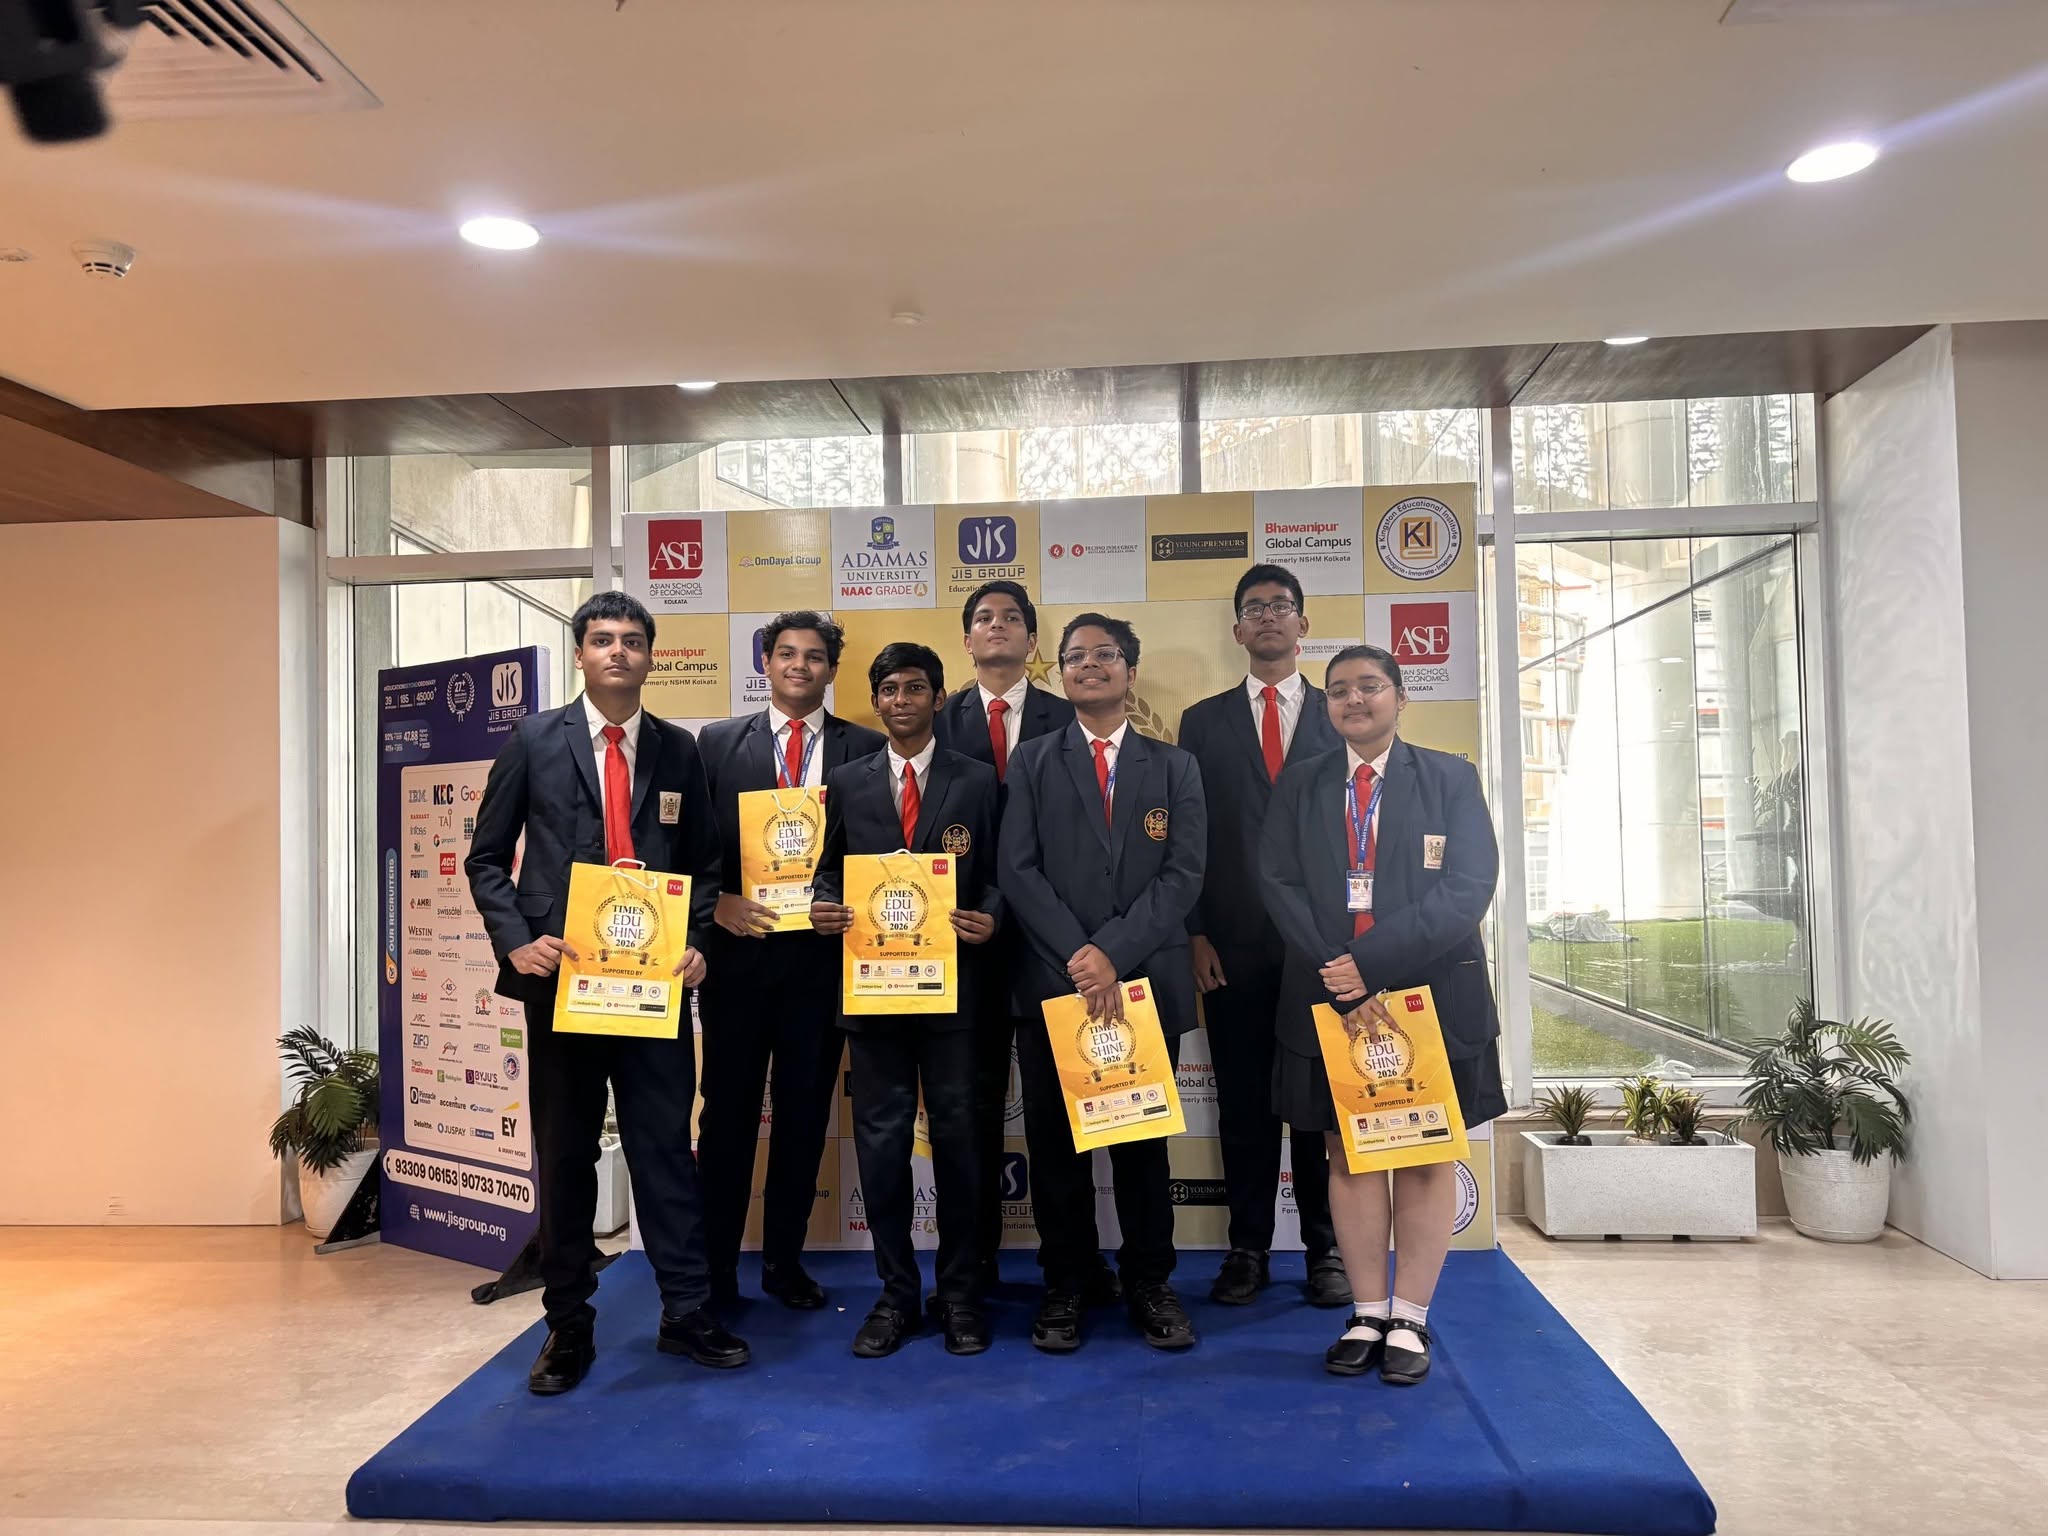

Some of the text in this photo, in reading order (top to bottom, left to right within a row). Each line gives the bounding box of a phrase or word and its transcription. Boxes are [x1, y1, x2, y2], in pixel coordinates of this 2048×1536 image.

[1379, 500, 1458, 542] Kingston Educational Institute
[1265, 522, 1339, 536] Bhawanipur
[1404, 522, 1431, 548] KI
[1265, 536, 1352, 550] Global Campus
[650, 541, 704, 571] ASE
[754, 556, 822, 566] OmDayal Group
[841, 550, 928, 568] ADAMAS
[1266, 556, 1298, 564] Formerly
[847, 570, 921, 581] UNIVERSITY
[952, 567, 1026, 579] JIS GROUP
[841, 586, 873, 596] NAAC
[875, 584, 912, 596] GRADE
[1391, 625, 1450, 656] ASE
[653, 647, 706, 660] awanipur
[650, 660, 718, 673] obal Campus
[642, 678, 668, 686] ormerly
[746, 679, 767, 689] JIS
[1404, 674, 1450, 682] ECONOMICS
[502, 708, 528, 719] GROUP
[408, 790, 428, 804] IBM
[433, 784, 454, 806] KEC
[777, 820, 804, 828] TIMES
[778, 828, 802, 838] EDU
[775, 838, 808, 850] SHINE
[440, 857, 455, 867] ACC
[883, 890, 914, 898] TIMES
[416, 898, 432, 907] AMRI
[885, 899, 911, 910] EDU
[612, 904, 645, 915] TIMES
[612, 914, 642, 927] EDU
[880, 910, 916, 922] SHINE
[890, 922, 908, 930] 2026
[606, 926, 646, 940] SHINE
[615, 938, 636, 948] 2026
[602, 968, 634, 976] SUPPORTED
[1092, 1031, 1119, 1046] EDU
[1090, 1041, 1126, 1058] SHINE
[1367, 1042, 1396, 1058] EDU
[1102, 1054, 1121, 1065] 2026
[1364, 1054, 1404, 1071] SHINE
[474, 1070, 498, 1084] BYJU'S
[1376, 1068, 1398, 1079] 2026
[1099, 1082, 1128, 1092] SUPPORTED
[440, 1100, 466, 1110] accenture
[1374, 1098, 1406, 1108] SUPPORTED
[444, 1126, 466, 1136] JUSPAY
[502, 1116, 518, 1138] EY
[514, 1149, 526, 1158] MORE
[395, 1158, 530, 1204] 93309 06153 90733 70470
[1458, 1168, 1476, 1199] Institute
[424, 1207, 506, 1242] www.jisgroup.org
